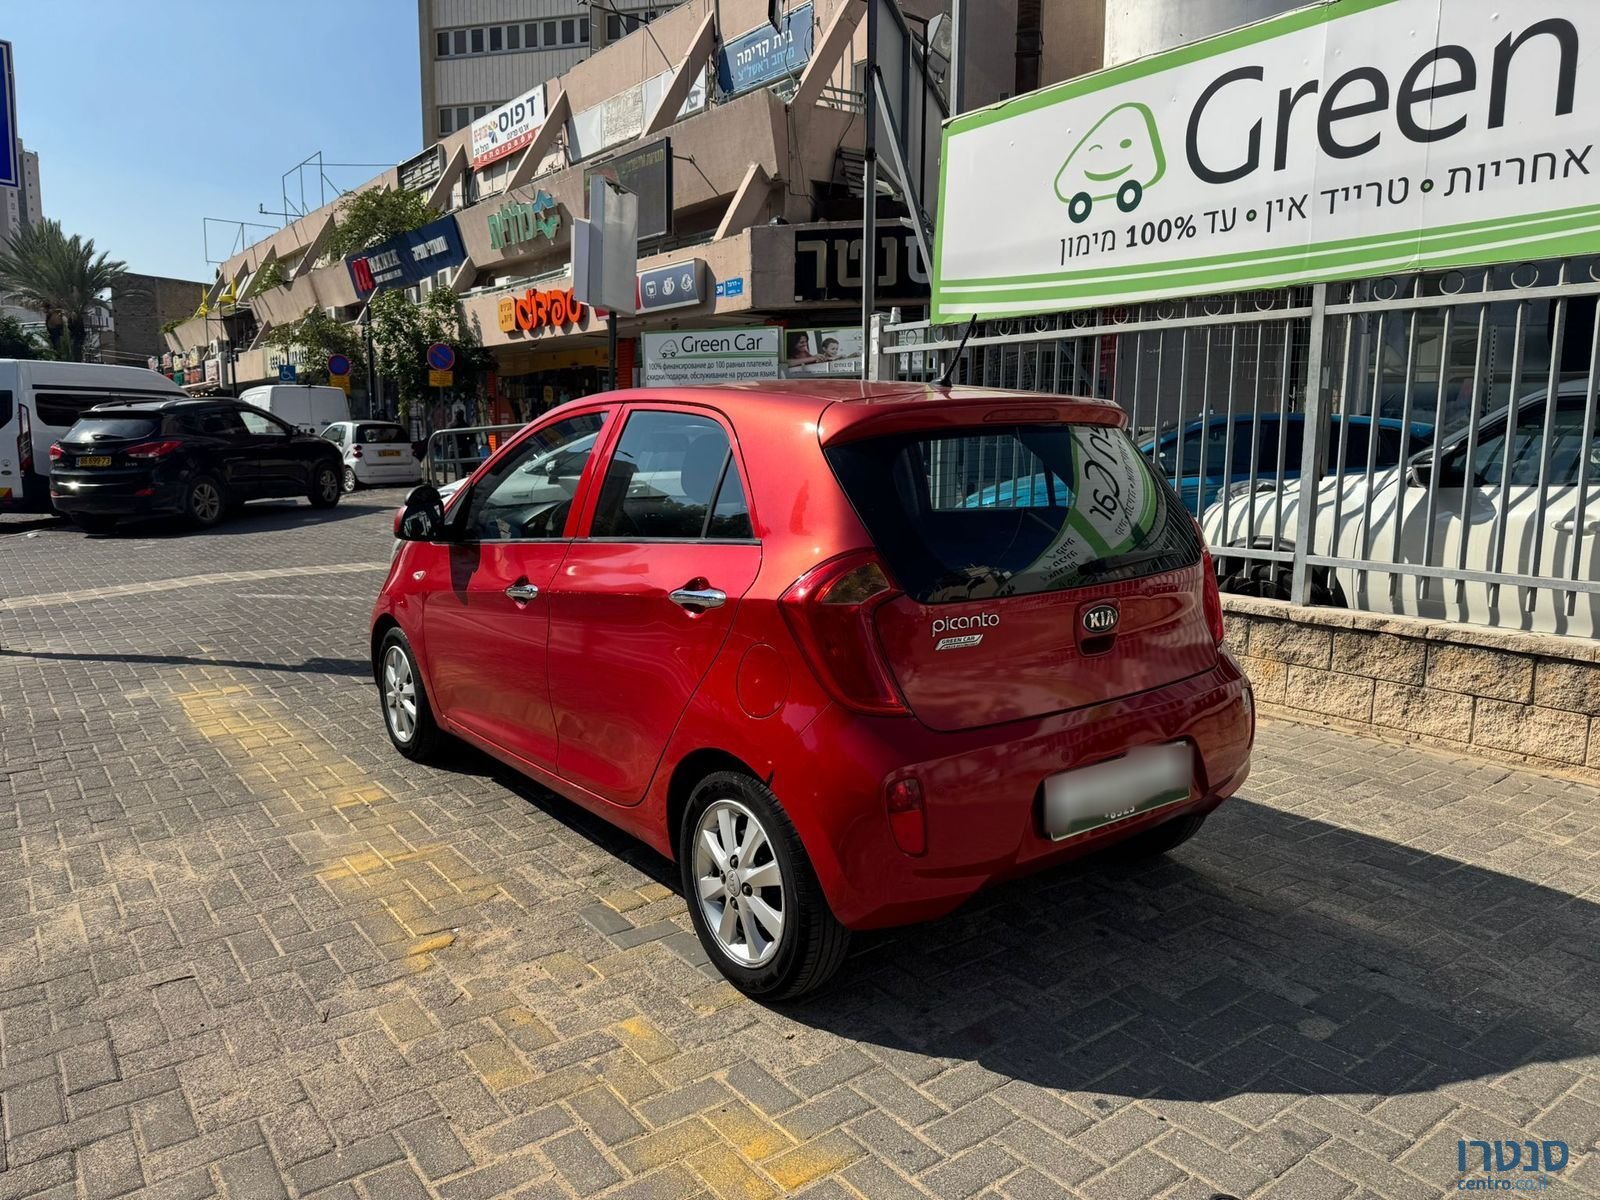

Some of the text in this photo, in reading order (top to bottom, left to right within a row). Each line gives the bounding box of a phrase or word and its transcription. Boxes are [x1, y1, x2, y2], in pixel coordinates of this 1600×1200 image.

[736, 38, 769, 66] קדימה
[498, 95, 536, 133] דפוס
[1185, 17, 1579, 185] Green
[1060, 144, 1594, 266] אחריות טרייד אין עד 100% מימון
[681, 333, 763, 353] Green Car
[715, 361, 726, 369] 100
[931, 611, 1000, 638] picanto
[1088, 609, 1114, 628] KIA
